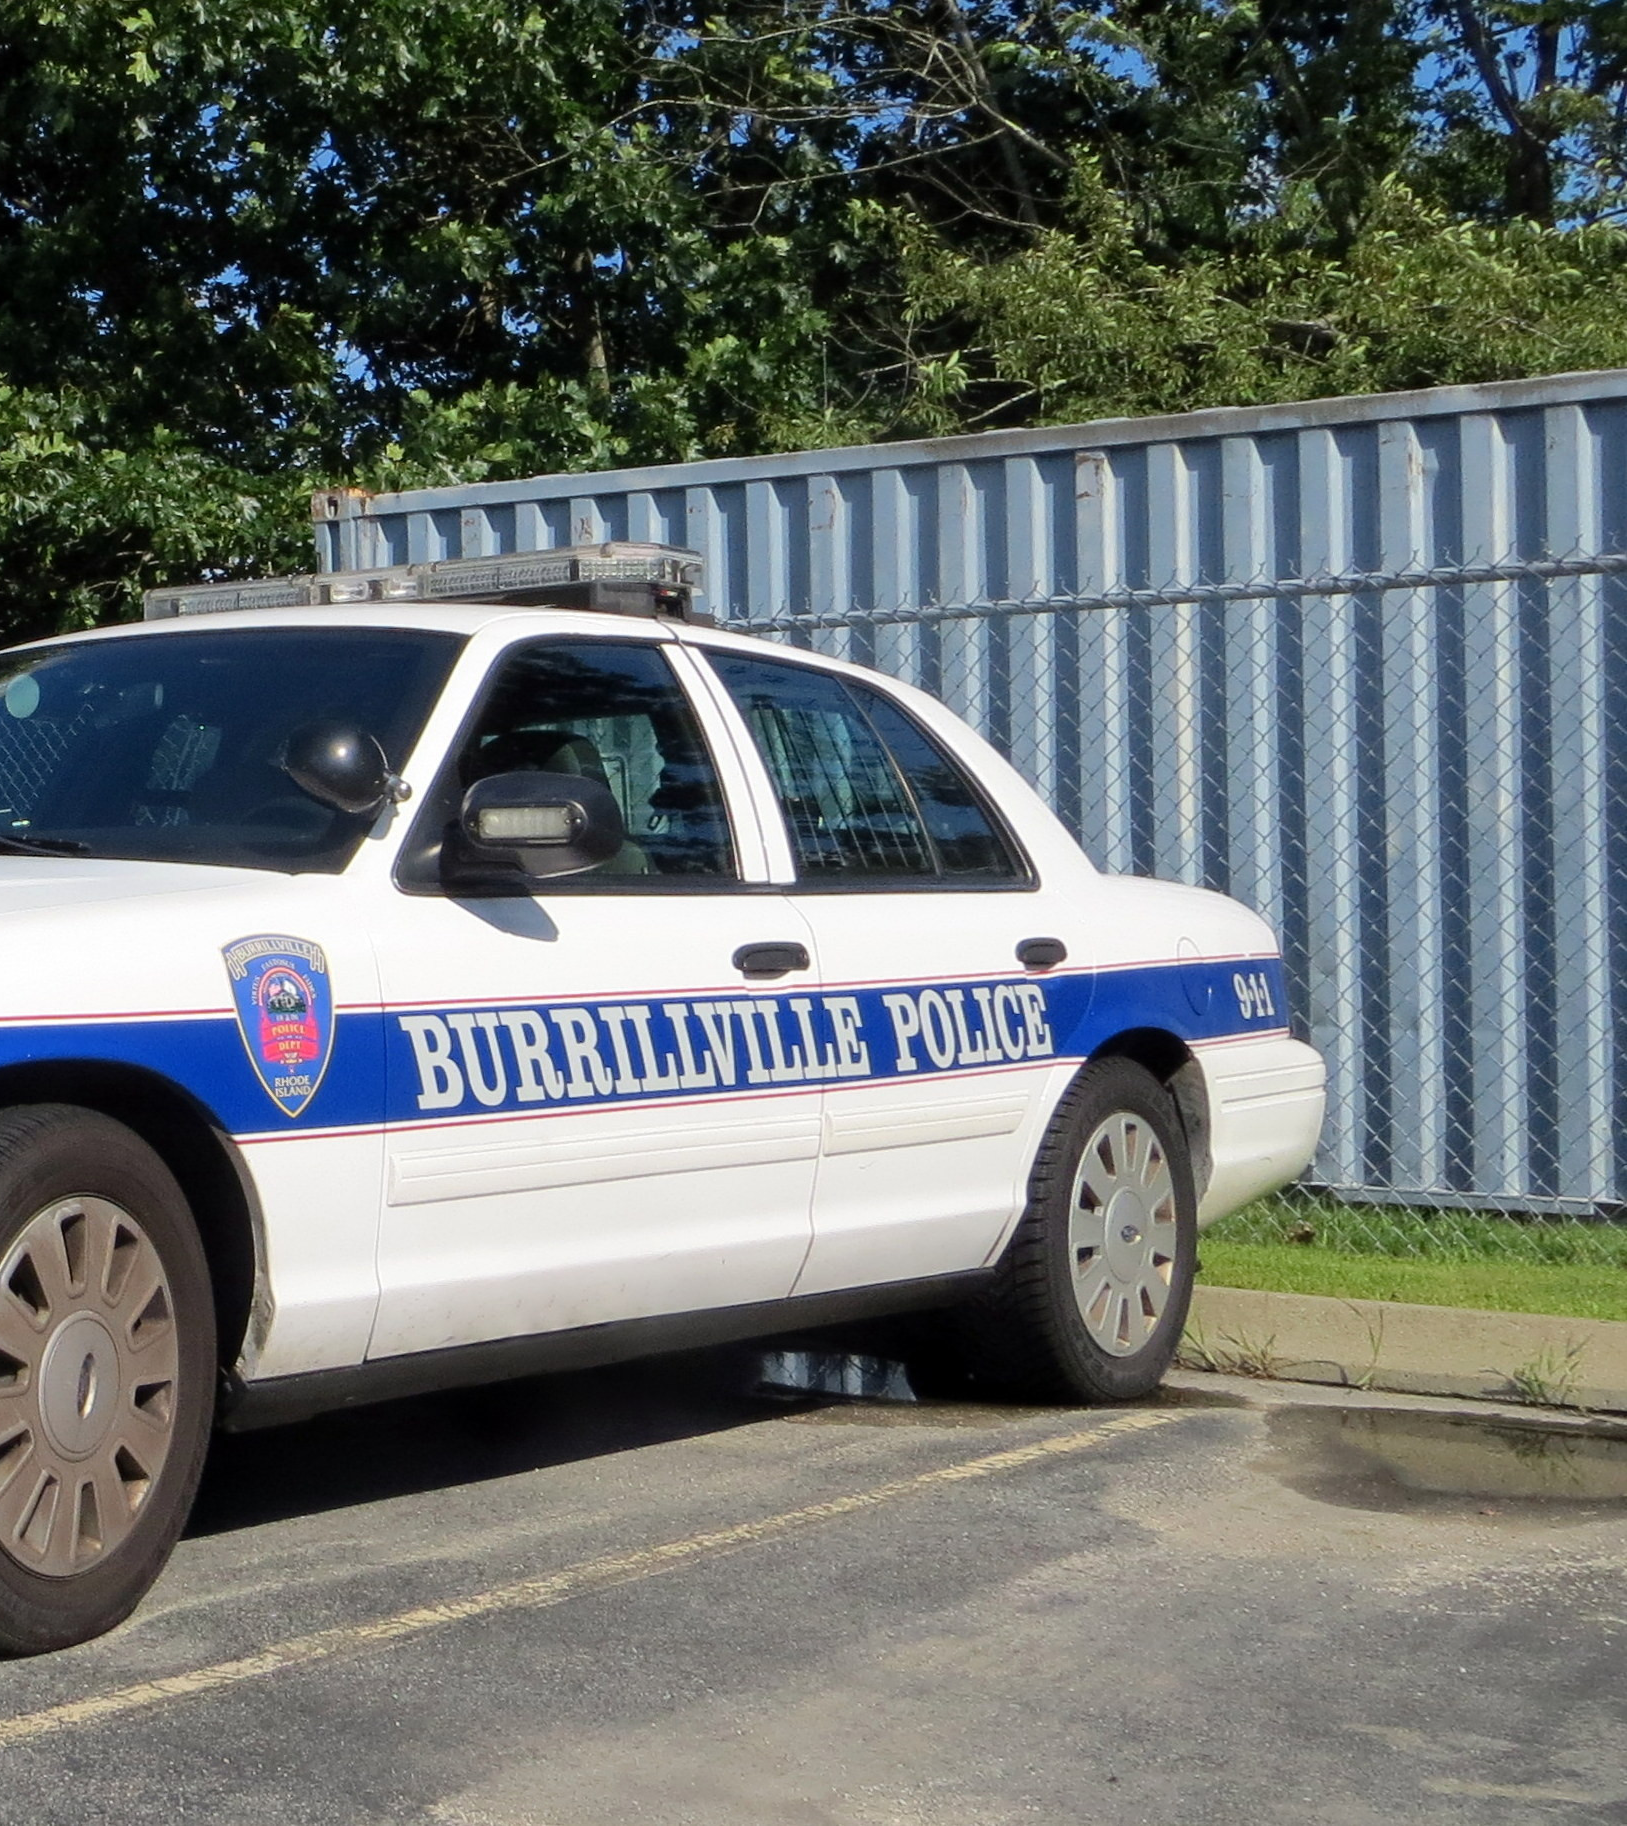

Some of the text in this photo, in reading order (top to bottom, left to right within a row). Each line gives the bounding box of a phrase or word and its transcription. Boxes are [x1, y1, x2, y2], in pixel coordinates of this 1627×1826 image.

[236, 939, 310, 959] BURRILLVILLE
[271, 1023, 307, 1036] POLICE
[398, 984, 1054, 1110] BURRILLVILLE POLICE
[274, 1074, 311, 1087] RHODE
[275, 1085, 312, 1098] ISLAND
